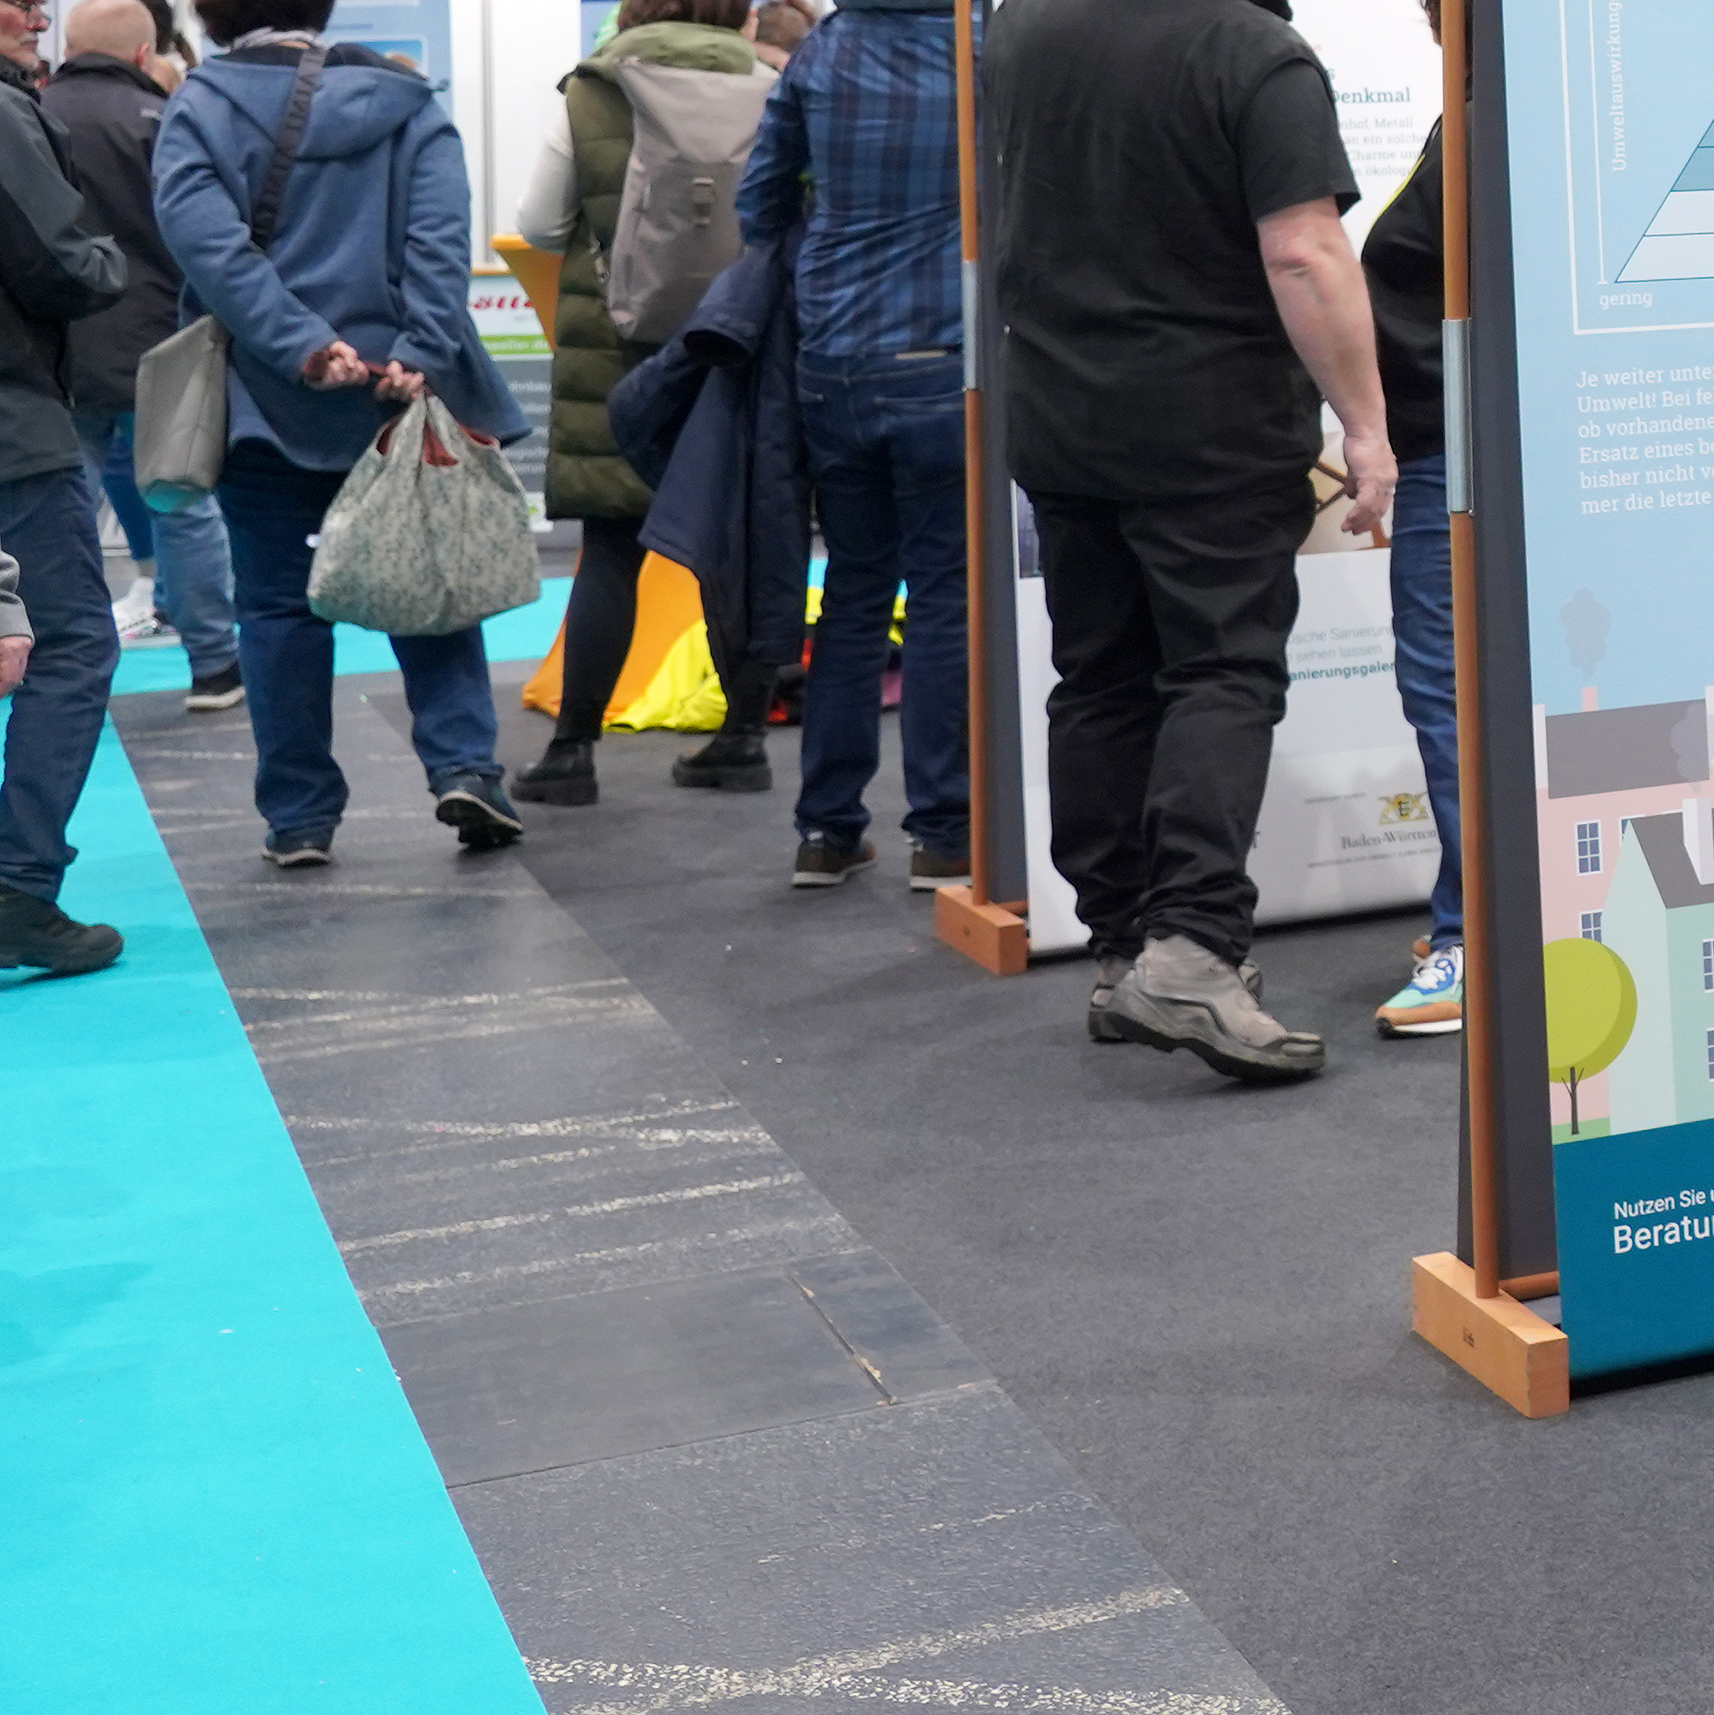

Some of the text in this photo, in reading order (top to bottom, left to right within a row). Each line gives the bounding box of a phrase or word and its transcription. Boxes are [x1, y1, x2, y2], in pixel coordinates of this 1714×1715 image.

[1600, 290, 1653, 310] gering
[1576, 370, 1598, 388] Je
[1603, 367, 1666, 385] weiter
[1577, 392, 1656, 412] Umwelt!
[1661, 389, 1692, 407] Bei
[1578, 420, 1601, 438] ob
[1579, 446, 1640, 464] Ersatz
[1644, 441, 1694, 458] eines
[1580, 470, 1640, 489] bisher
[1645, 464, 1696, 484] nicht
[1581, 498, 1620, 514] mer
[1624, 493, 1654, 510] die
[1659, 490, 1712, 508] letzte
[1614, 1196, 1676, 1219] Nutzen
[1679, 1189, 1706, 1208] Sie
